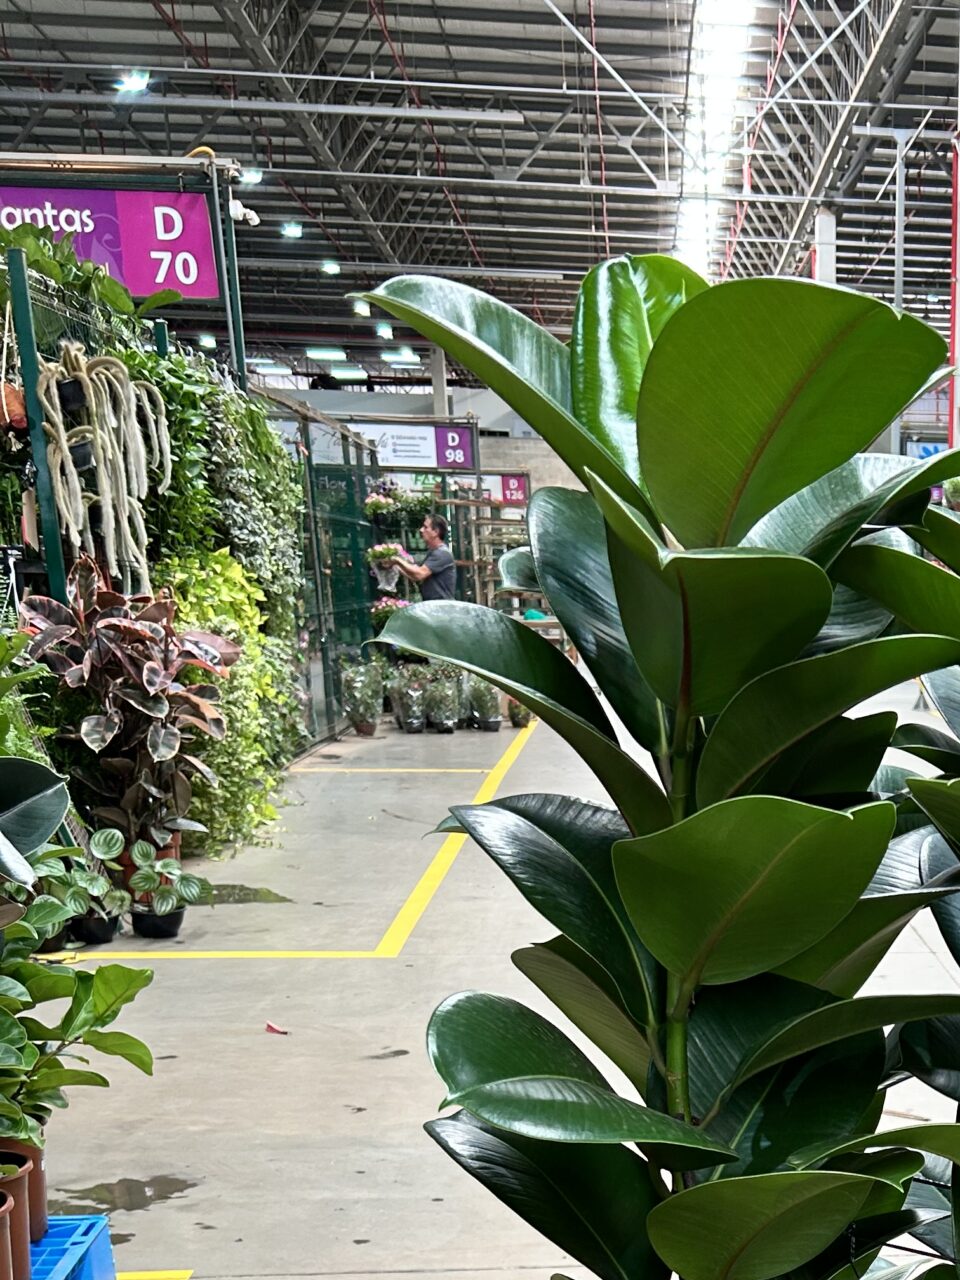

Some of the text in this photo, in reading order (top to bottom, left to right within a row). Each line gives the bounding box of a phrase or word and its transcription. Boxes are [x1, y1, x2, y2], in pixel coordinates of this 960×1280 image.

[153, 206, 183, 241] D
[150, 251, 198, 285] 70
[447, 432, 460, 447] D
[445, 449, 465, 464] 98
[509, 478, 518, 490] D
